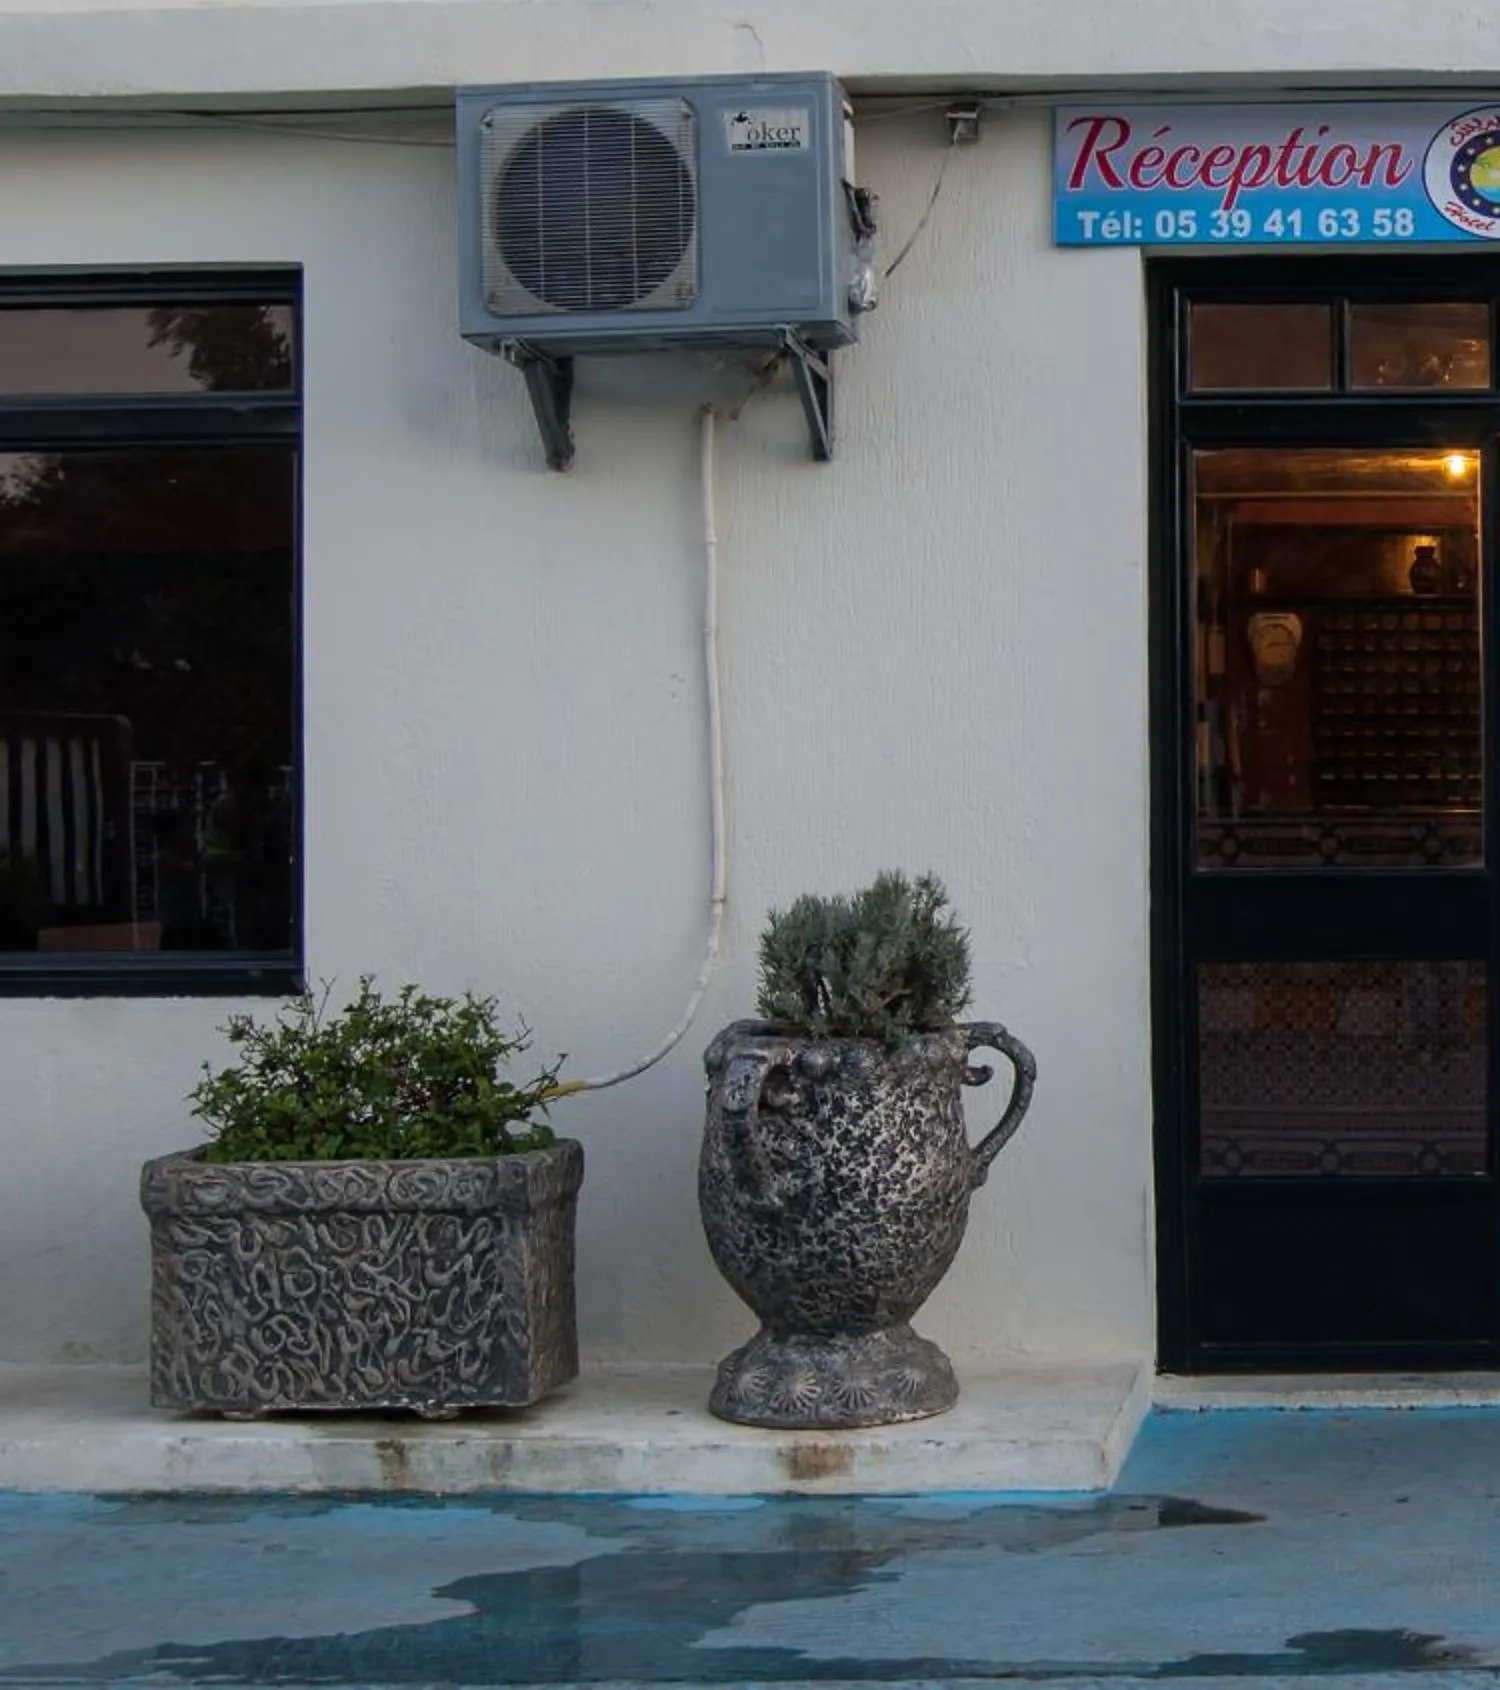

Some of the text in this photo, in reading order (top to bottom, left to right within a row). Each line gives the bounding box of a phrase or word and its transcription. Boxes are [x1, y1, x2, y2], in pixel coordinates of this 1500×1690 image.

[1067, 115, 1413, 213] Réception
[1078, 209, 1415, 240] Tél: 05 39 41 63 58
[1443, 201, 1496, 232] Hotel
